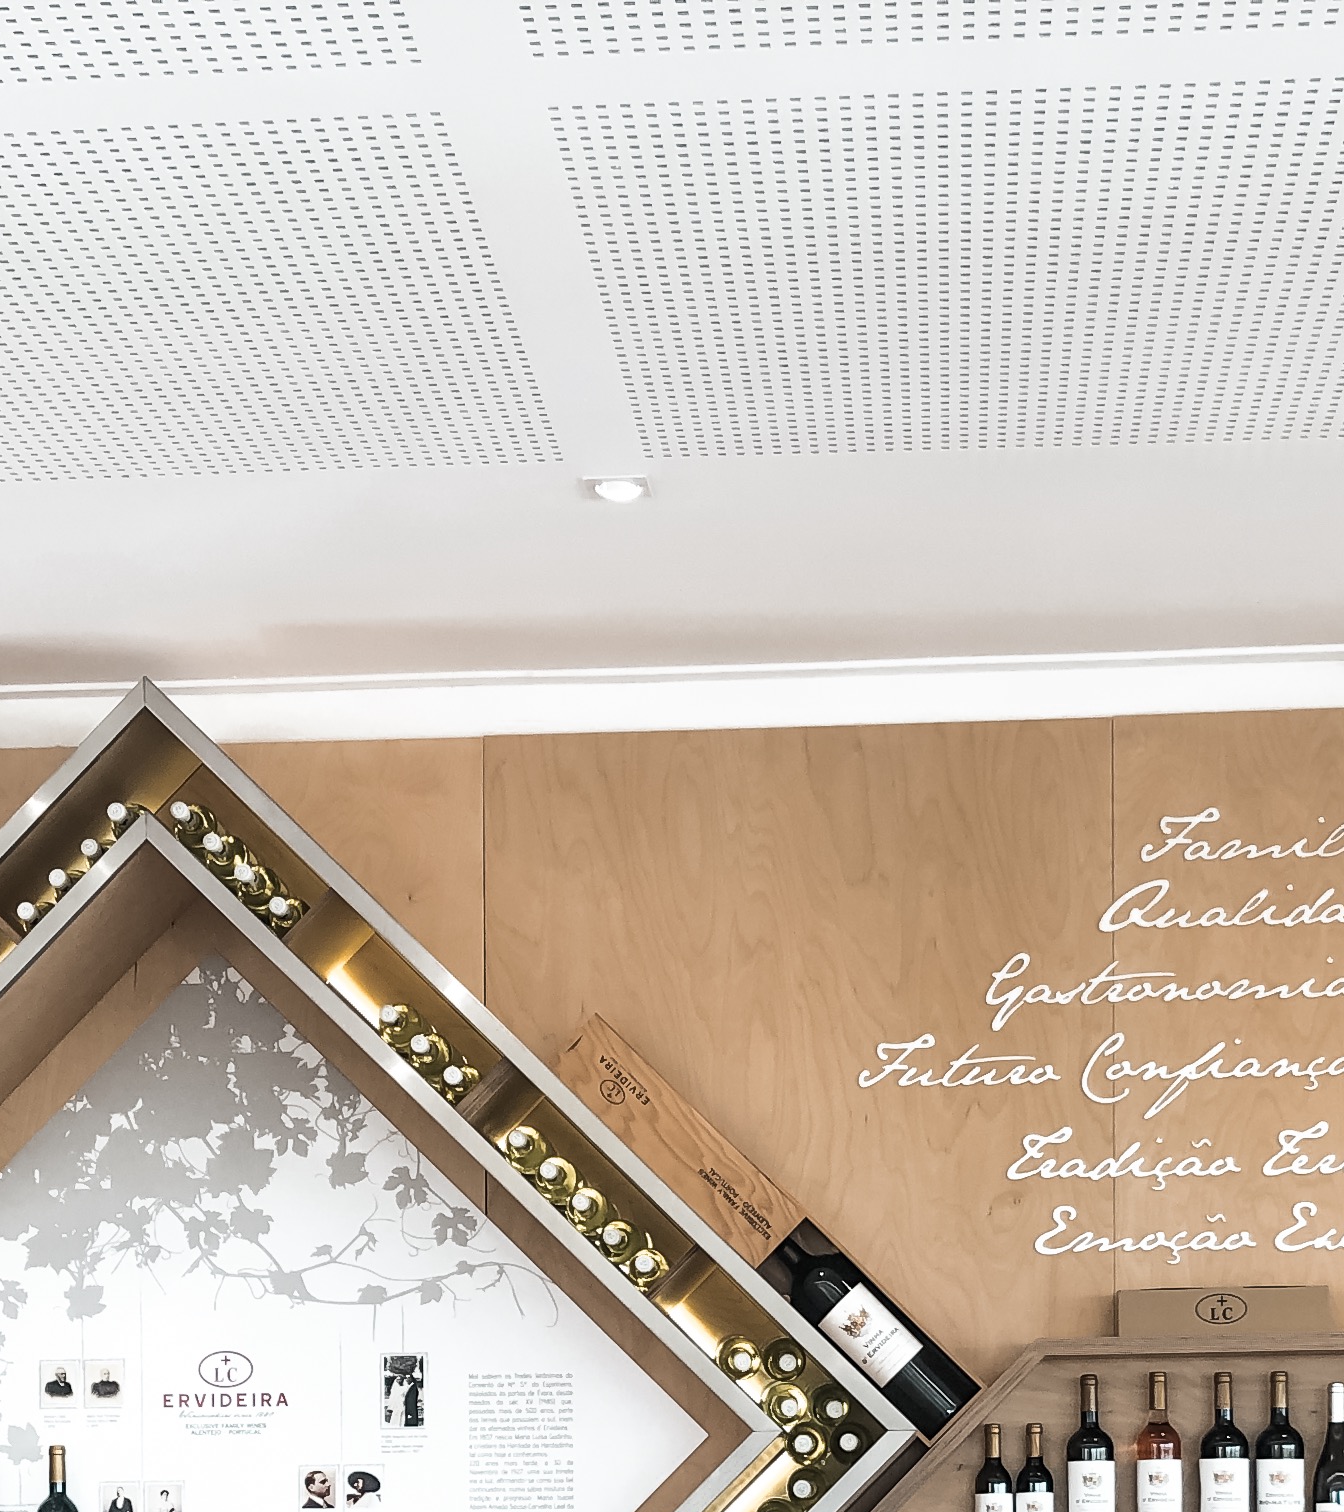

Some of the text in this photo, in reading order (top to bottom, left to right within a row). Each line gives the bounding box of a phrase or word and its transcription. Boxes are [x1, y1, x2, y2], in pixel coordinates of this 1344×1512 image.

[599, 1054, 651, 1106] ERVIDEIRA
[859, 1034, 1061, 1088] Futuro
[1007, 1127, 1241, 1191] Tradição
[1035, 1206, 1256, 1265] Emoção
[1209, 1307, 1233, 1321] LC
[163, 1392, 289, 1408] ERVIDEIRA
[213, 1367, 238, 1382] LC
